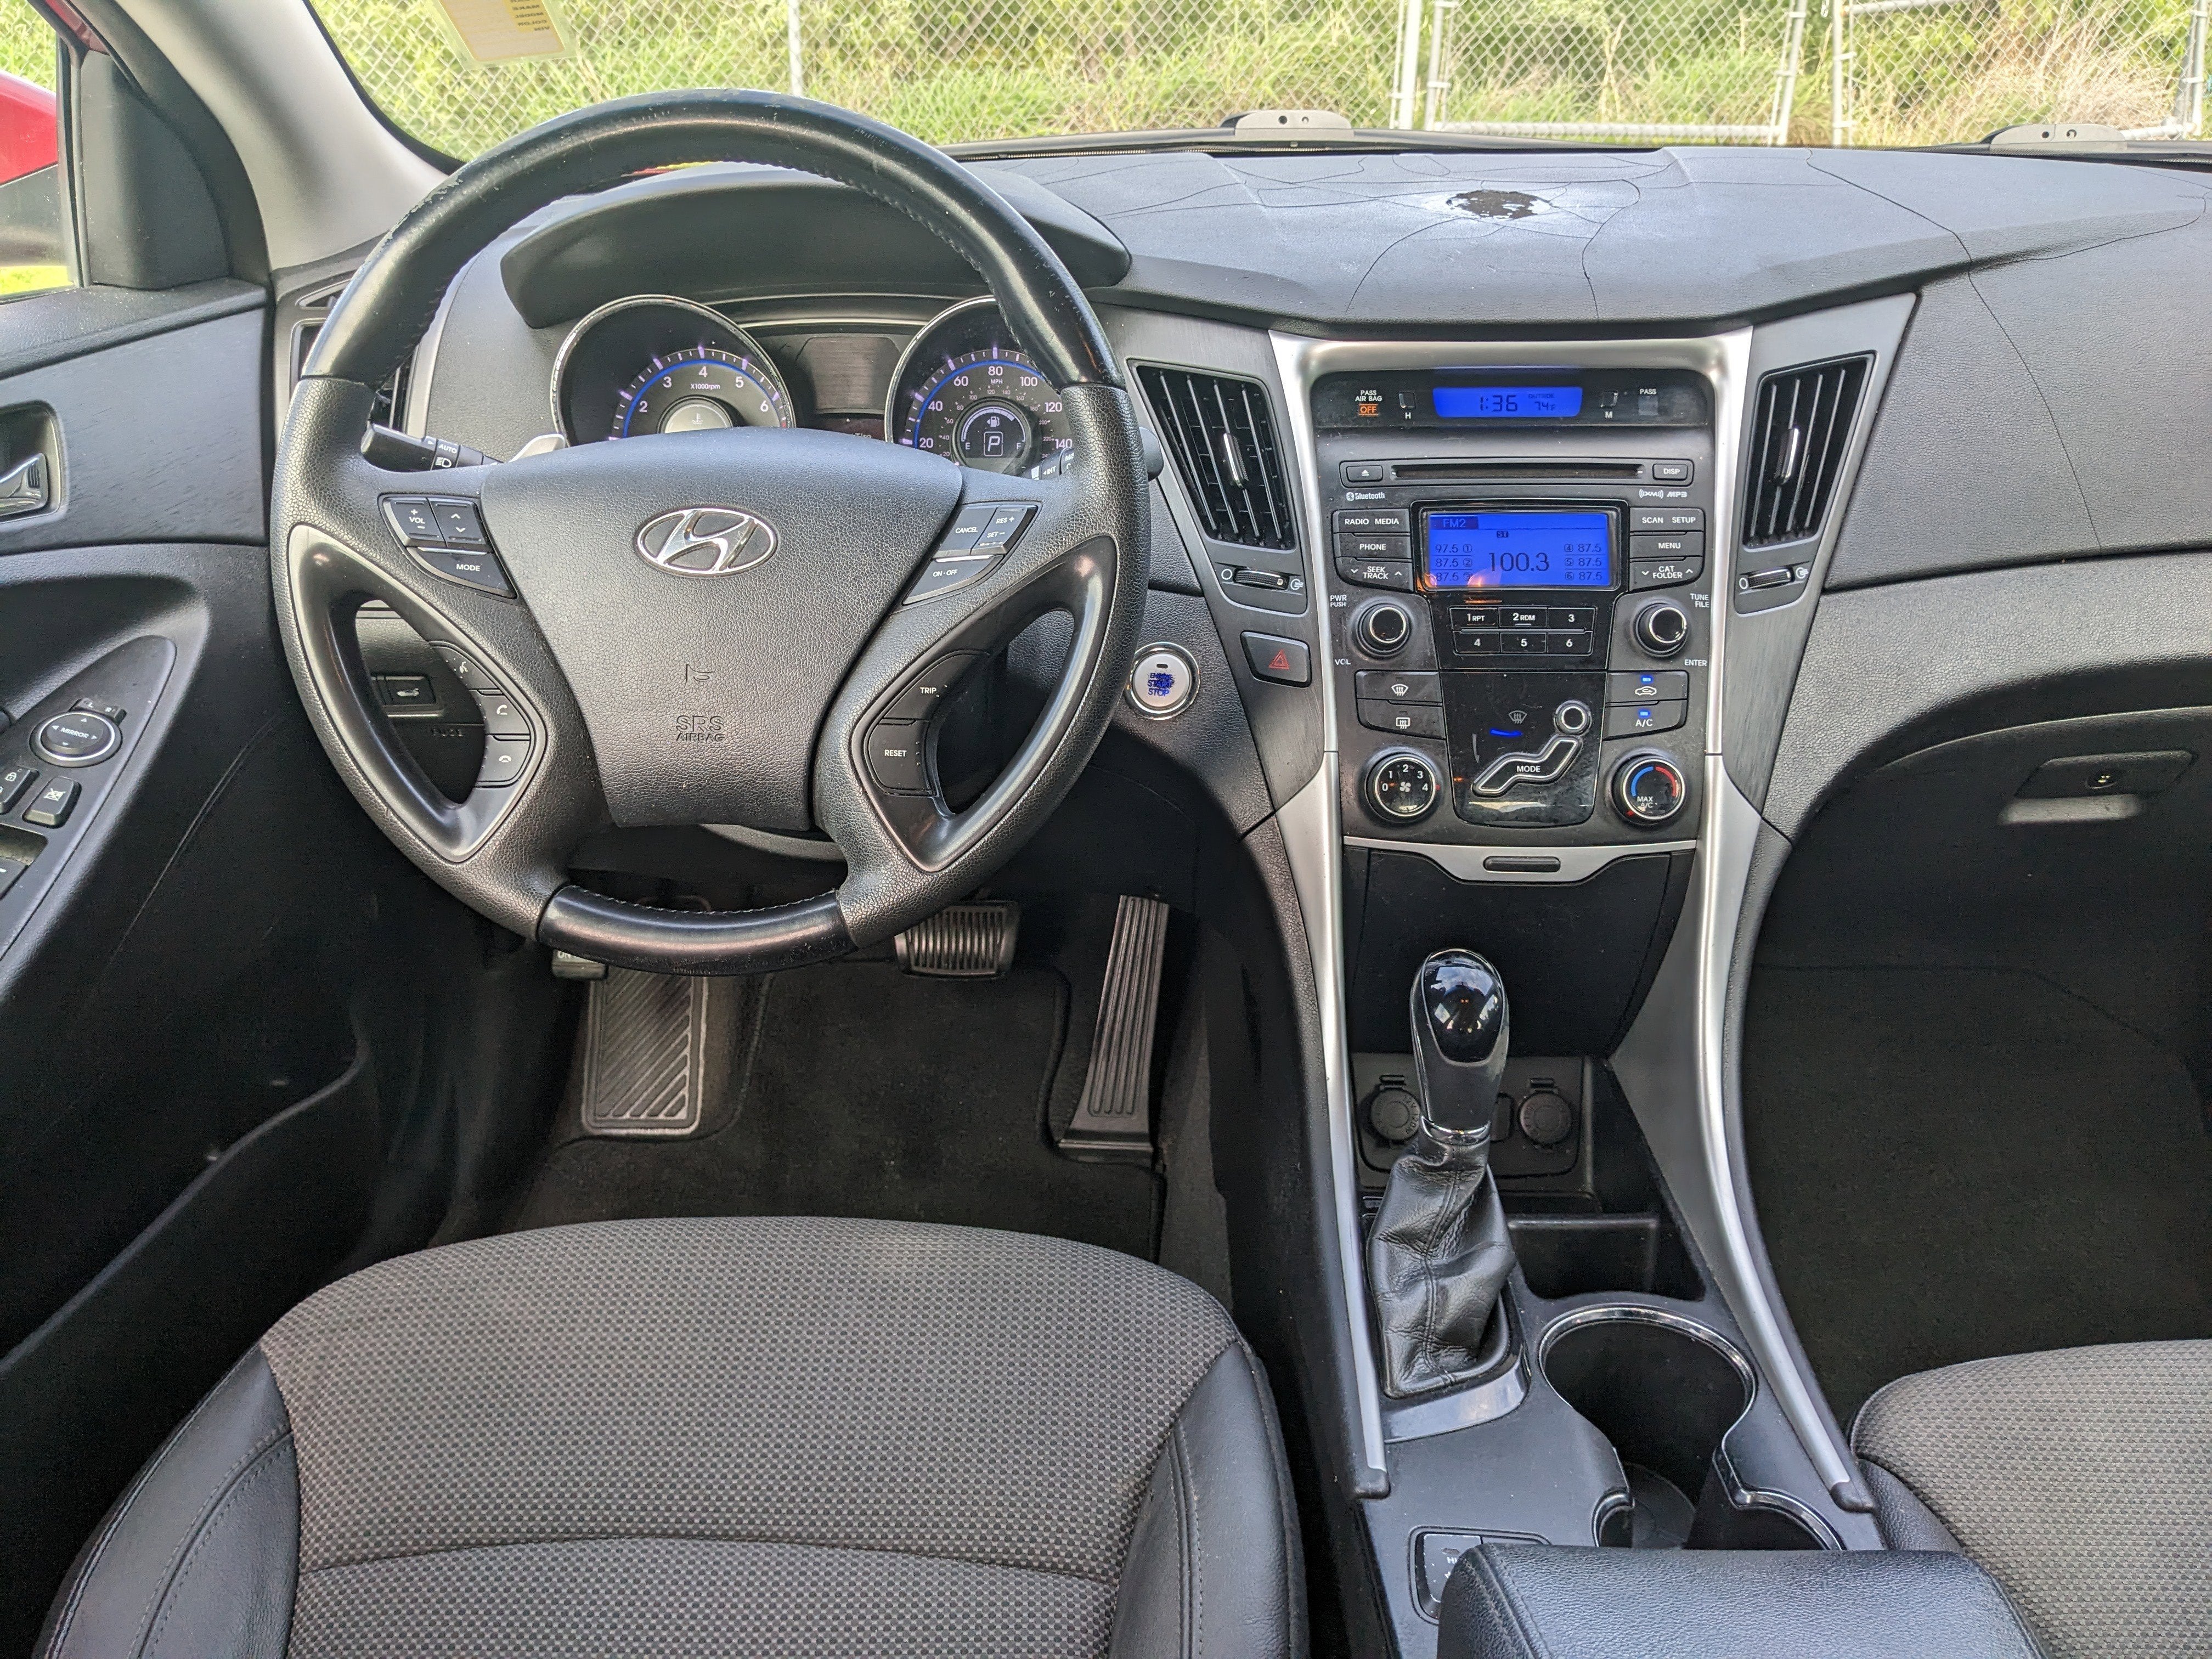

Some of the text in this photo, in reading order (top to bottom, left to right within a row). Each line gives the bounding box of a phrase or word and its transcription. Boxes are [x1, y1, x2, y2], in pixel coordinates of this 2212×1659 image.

[698, 366, 708, 377] 4
[988, 366, 1003, 376] 80
[663, 376, 672, 388] 3
[735, 376, 744, 388] 5
[953, 376, 968, 386] 60
[1020, 376, 1037, 387] 100
[639, 400, 648, 413] 2
[760, 400, 769, 412] 6
[928, 400, 943, 411] 40
[1045, 402, 1062, 412] 120
[1480, 394, 1518, 412] 1:36
[919, 438, 934, 448] 20
[988, 436, 1000, 452] P
[1054, 438, 1073, 449] 140
[439, 444, 457, 454] AUTO
[1355, 492, 1385, 500] Bluetooth
[409, 516, 426, 524] VOL
[1443, 518, 1466, 528] FM2
[1435, 544, 1458, 553] 97.5
[1578, 544, 1601, 552] 87.5
[1435, 558, 1459, 567] 87.5
[1488, 552, 1549, 572] 100.3
[1578, 558, 1601, 567] 87.5
[456, 563, 481, 572] MODE
[1579, 572, 1602, 581] 87.5
[1467, 613, 1471, 622] 1
[1513, 612, 1520, 621] 2
[1568, 614, 1575, 623] 3
[1474, 638, 1481, 647] 4
[1520, 639, 1528, 647] 5
[1566, 639, 1573, 647] 6
[676, 715, 725, 732] SRS
[60, 727, 89, 738] MIRROR
[675, 732, 725, 742] AIRBAG
[1402, 764, 1409, 772] 2
[1389, 770, 1393, 778] 1
[1417, 770, 1424, 779] 3
[1382, 783, 1389, 792] 0
[1422, 783, 1429, 792] 4
